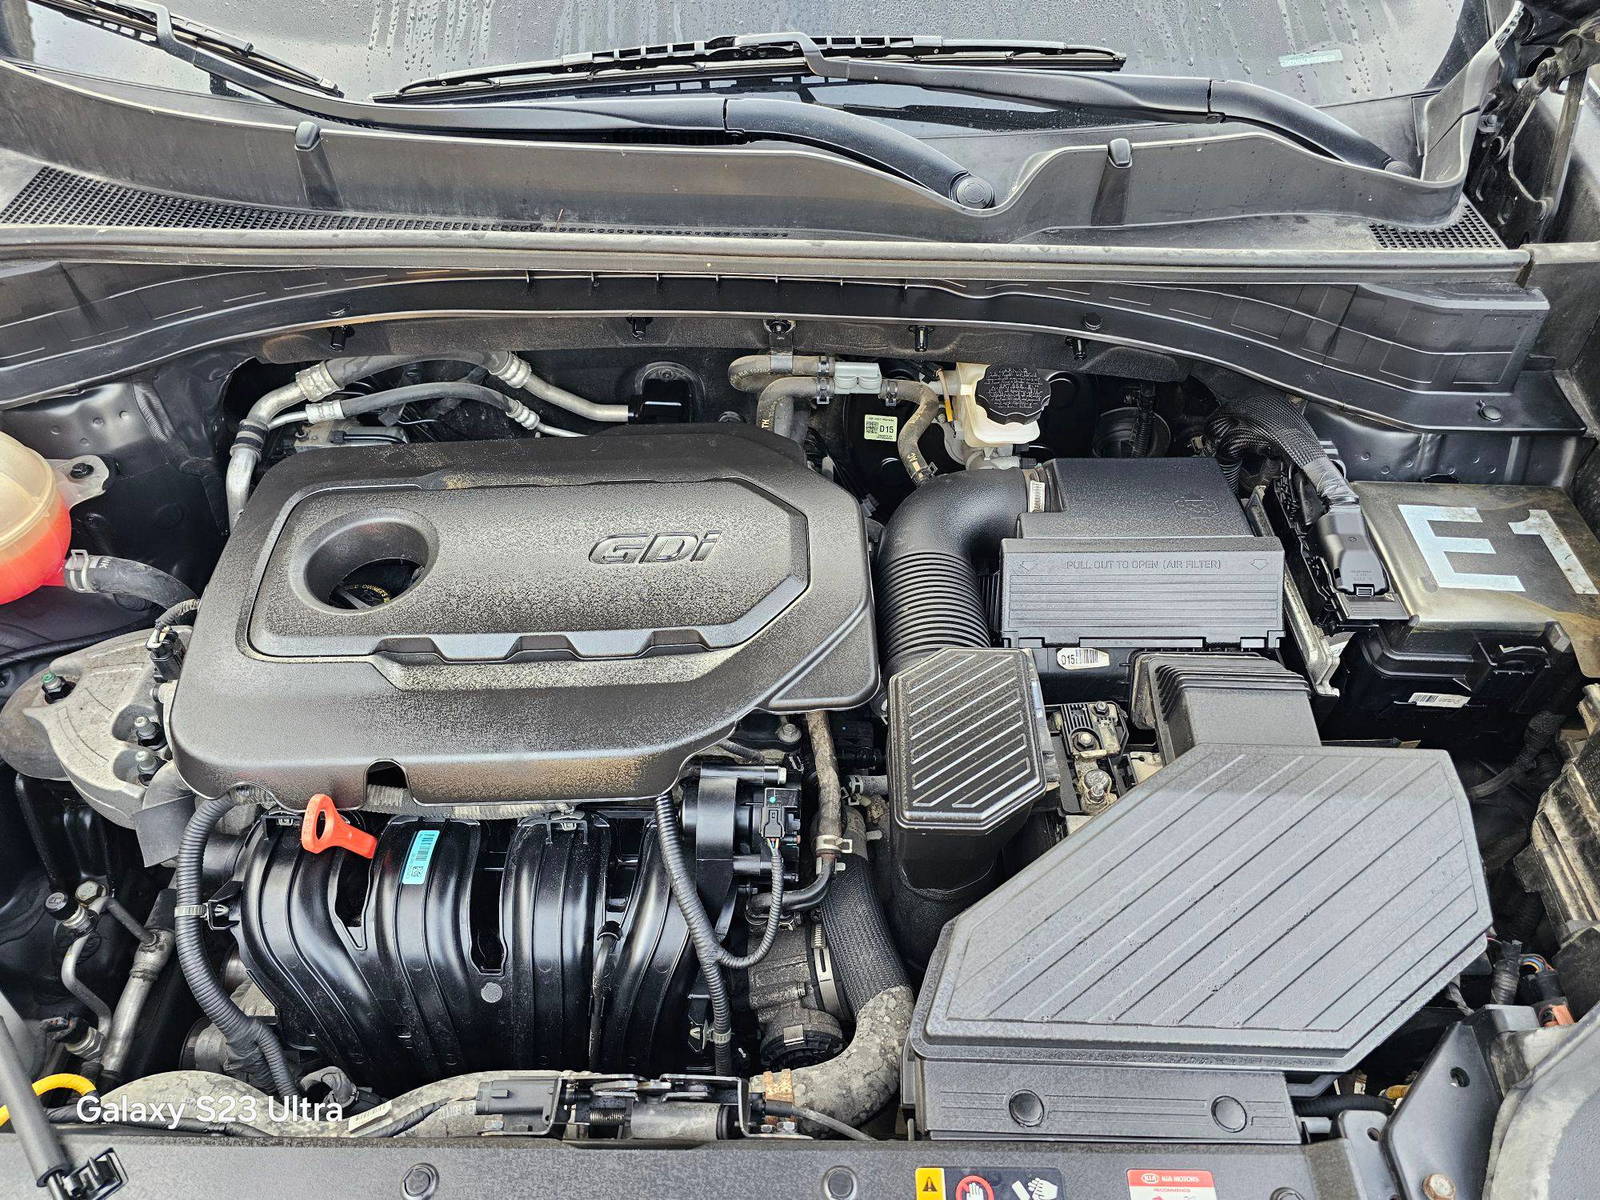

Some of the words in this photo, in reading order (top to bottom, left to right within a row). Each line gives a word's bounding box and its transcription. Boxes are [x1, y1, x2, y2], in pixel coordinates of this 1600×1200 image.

[588, 530, 722, 564] GDi
[1397, 504, 1600, 595] E1
[1066, 560, 1090, 570] PULL
[1093, 560, 1113, 570] OUT
[1117, 560, 1129, 569] TO
[1132, 560, 1159, 569] OPEN
[1162, 559, 1183, 570] (AIR
[1185, 559, 1221, 570] FILTER)
